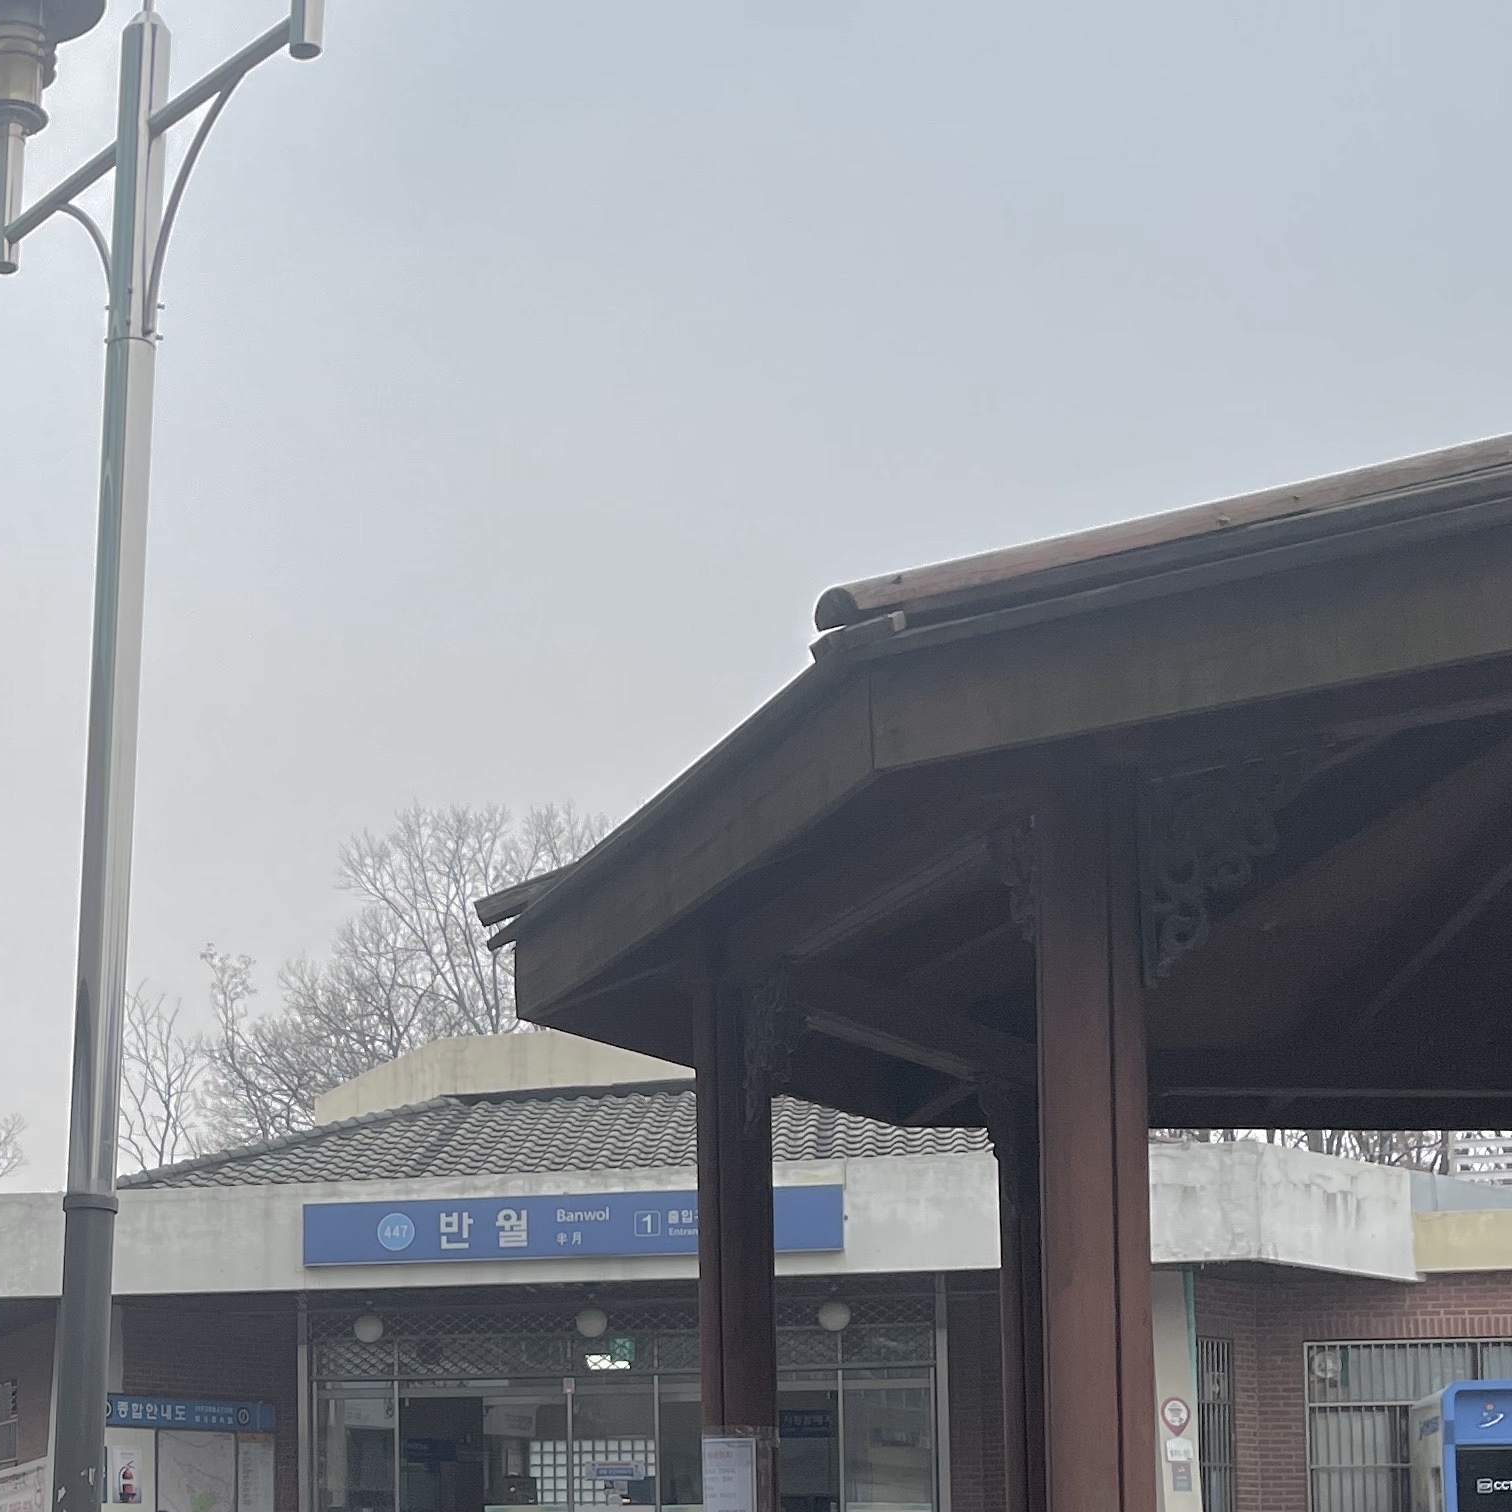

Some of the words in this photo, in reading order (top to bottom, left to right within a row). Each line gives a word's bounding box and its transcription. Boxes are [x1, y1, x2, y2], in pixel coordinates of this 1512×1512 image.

[556, 1206, 610, 1223] Banwol
[384, 1224, 409, 1240] 447
[117, 1400, 187, 1422] 종합안내도
